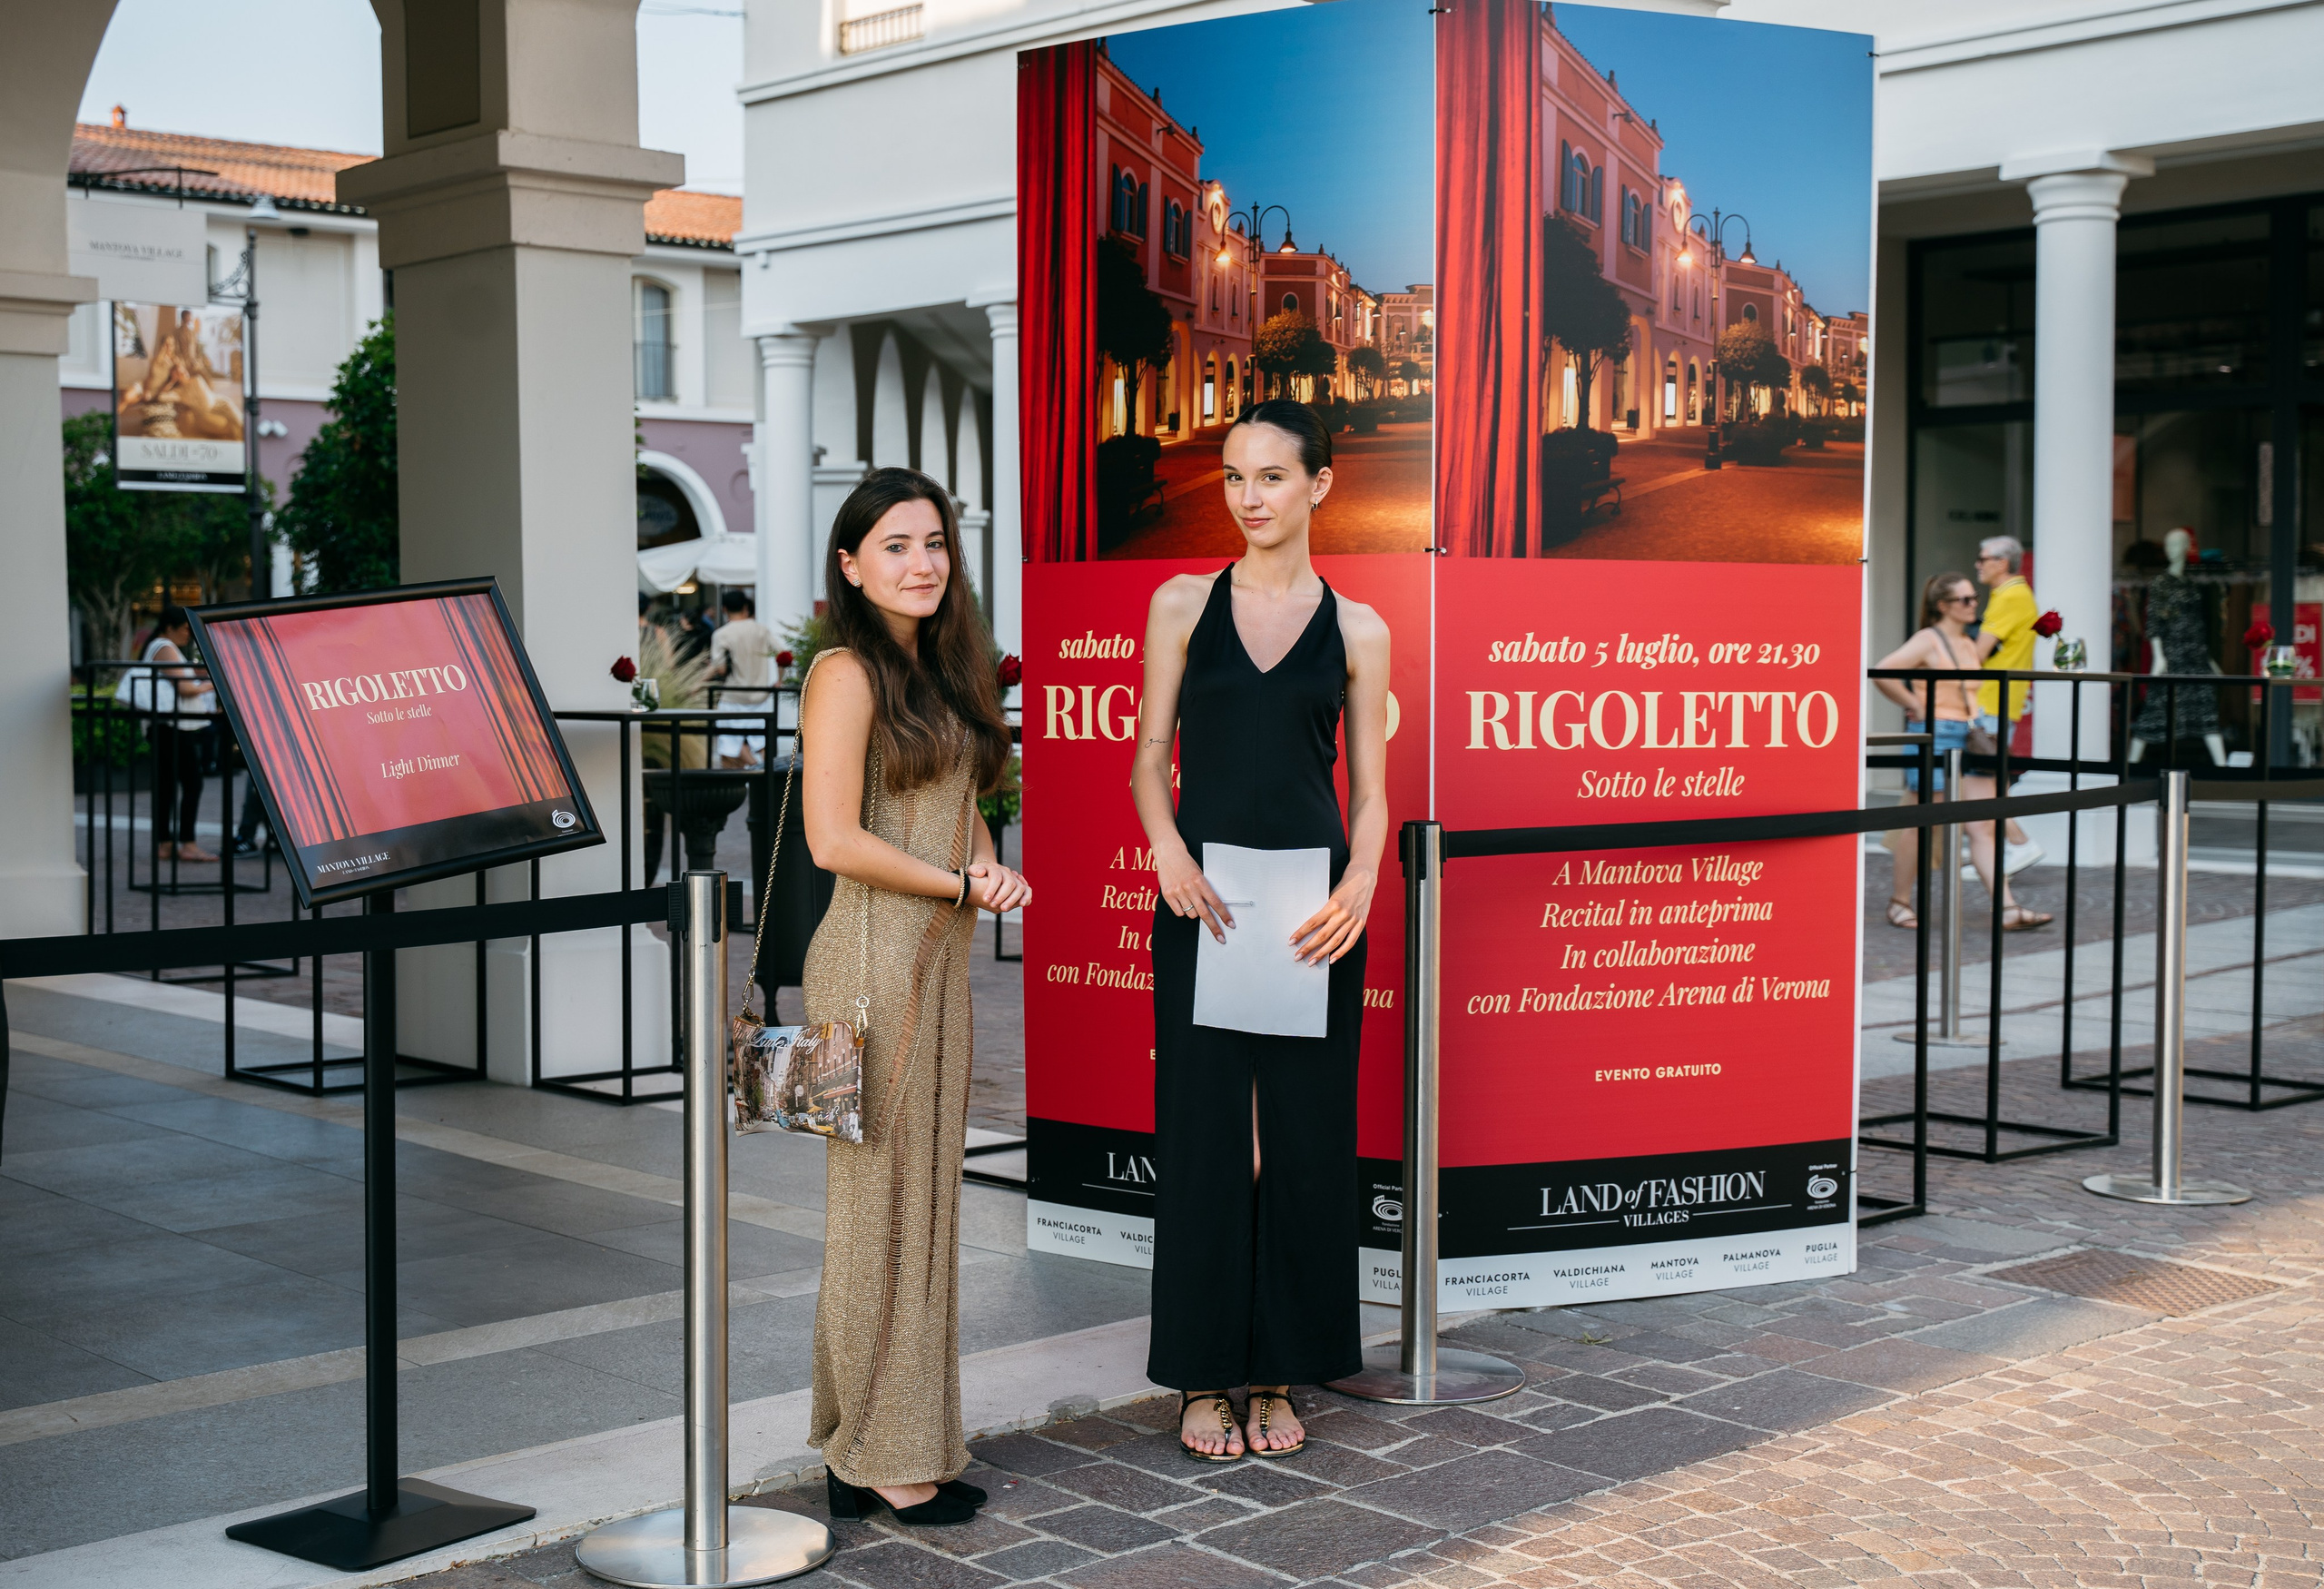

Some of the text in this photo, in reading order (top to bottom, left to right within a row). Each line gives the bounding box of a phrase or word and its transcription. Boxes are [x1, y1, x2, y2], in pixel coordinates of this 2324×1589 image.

[1059, 630, 1136, 659] sabato
[1488, 631, 1820, 670] sabato 5 luglio, ore 21.30
[301, 664, 468, 711] RIGOLETTO
[366, 704, 433, 725] Sotto le stelle
[1464, 690, 1839, 751] RIGOLETTO
[380, 754, 460, 780] Light Dinner
[1577, 766, 1746, 799] Sotto le stelle
[317, 852, 391, 874] MANTOVA VILLAGE
[1109, 846, 1126, 870] A
[1551, 854, 1764, 887] A Mantova Village
[1540, 895, 1774, 929] Recital in anteprima
[1118, 925, 1140, 951] In
[1560, 937, 1756, 970] In collaborazione
[1047, 964, 1080, 984] con
[1467, 975, 1831, 1015] con Fondazione Arena di Verona
[790, 1028, 824, 1055] Italy
[1595, 1062, 1722, 1082] EVENTO GRATUITO
[1540, 1170, 1767, 1216] LAND of FASHION
[1037, 1217, 1102, 1236] FRANCIACORTA
[1623, 1209, 1690, 1227] VILLAGES
[1052, 1231, 1086, 1245] VILLAGE
[1805, 1241, 1838, 1252] PUGLIA
[1650, 1257, 1699, 1269] MANTOVA
[1722, 1248, 1781, 1262] PALMANOVA
[1804, 1252, 1838, 1264] VILLAGE
[1553, 1264, 1626, 1278] VALDICHIANA
[1656, 1268, 1694, 1280] VILLAGE
[1733, 1261, 1770, 1273] VILLAGE
[1444, 1272, 1531, 1286] FRANCIACORTA
[1570, 1277, 1610, 1289] VILLAGE
[1465, 1286, 1509, 1297] VILLAGE
